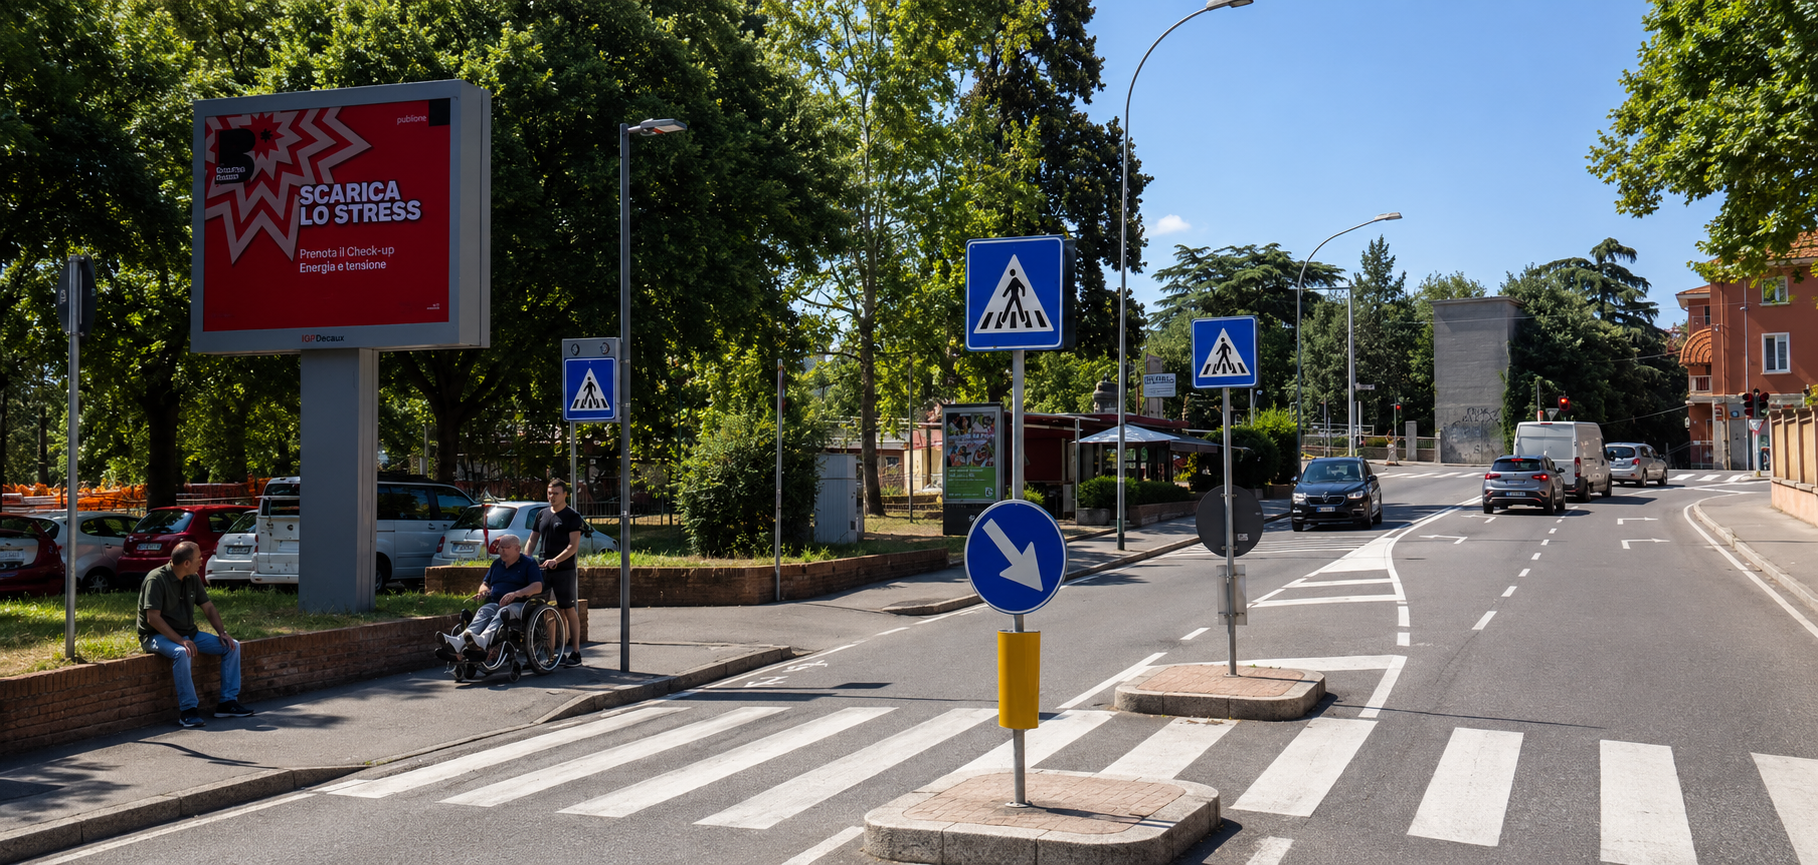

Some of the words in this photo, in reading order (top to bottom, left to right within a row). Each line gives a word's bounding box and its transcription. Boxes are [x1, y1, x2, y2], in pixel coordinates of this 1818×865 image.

[299, 180, 401, 205] SCARICA
[300, 205, 329, 225] LO
[334, 200, 421, 224] STRESS
[300, 248, 337, 259] Prenota
[339, 246, 345, 257] il
[346, 245, 395, 257] Check-up
[300, 261, 335, 274] Energia
[337, 263, 344, 271] e
[346, 259, 387, 271] tensione
